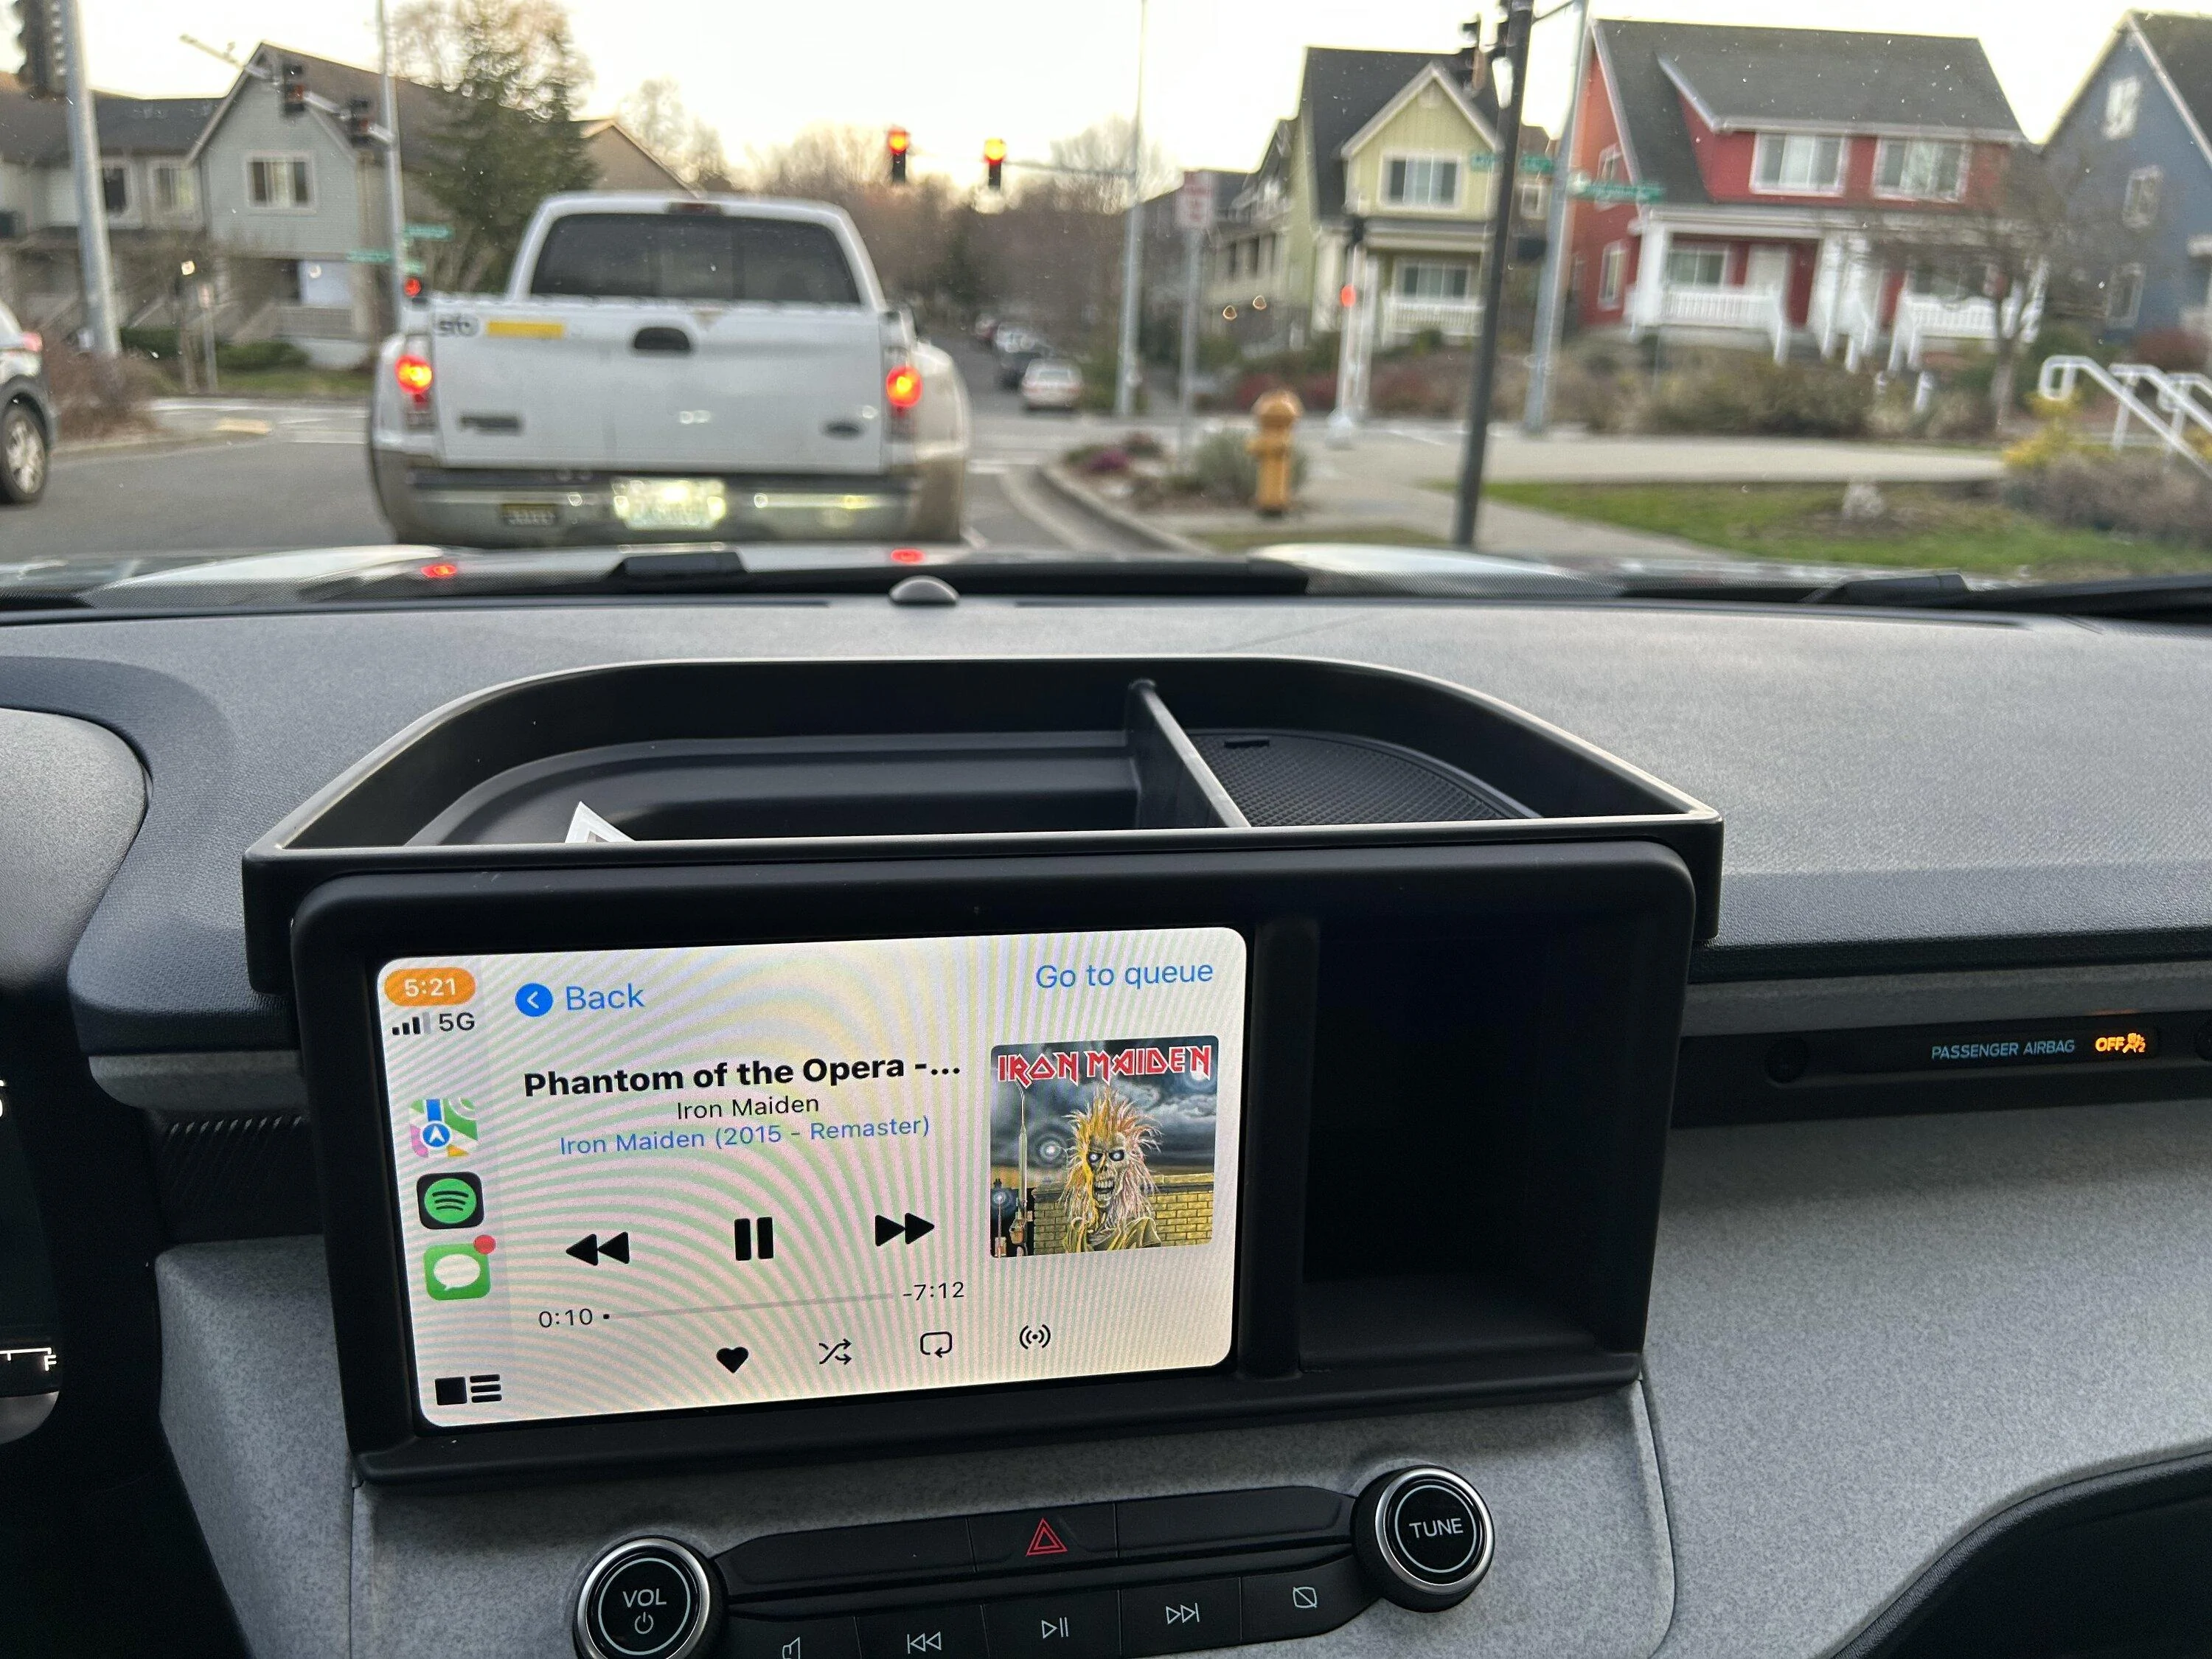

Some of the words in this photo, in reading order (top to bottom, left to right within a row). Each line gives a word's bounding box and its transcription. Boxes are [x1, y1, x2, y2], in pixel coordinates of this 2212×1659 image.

[1036, 964, 1074, 988] Go
[1087, 965, 1115, 987] to
[1124, 963, 1214, 989] queue
[404, 978, 456, 998] 5:21
[566, 983, 645, 1011] Back
[439, 1012, 476, 1032] 5G
[1931, 1041, 2019, 1060] PASSENGER
[2023, 1038, 2076, 1055] AIRBAG
[2095, 1036, 2125, 1053] OFF
[524, 1068, 684, 1096] Phantom
[693, 1062, 728, 1088] of
[737, 1060, 794, 1086] the
[803, 1057, 905, 1087] Opera
[997, 1051, 1080, 1089] IRON
[1085, 1045, 1213, 1087] MAIDEN
[677, 1102, 723, 1120] Iron
[732, 1096, 819, 1117] Maiden
[560, 1136, 607, 1155] Iron
[616, 1130, 706, 1153] Maiden
[715, 1124, 782, 1150] (2015
[810, 1116, 930, 1141] Remaster)
[902, 1281, 965, 1301] -7:12
[538, 1308, 594, 1328] 0:10
[44, 1354, 57, 1371] F
[1408, 1517, 1464, 1539] TUNE
[622, 1587, 667, 1608] VOL
